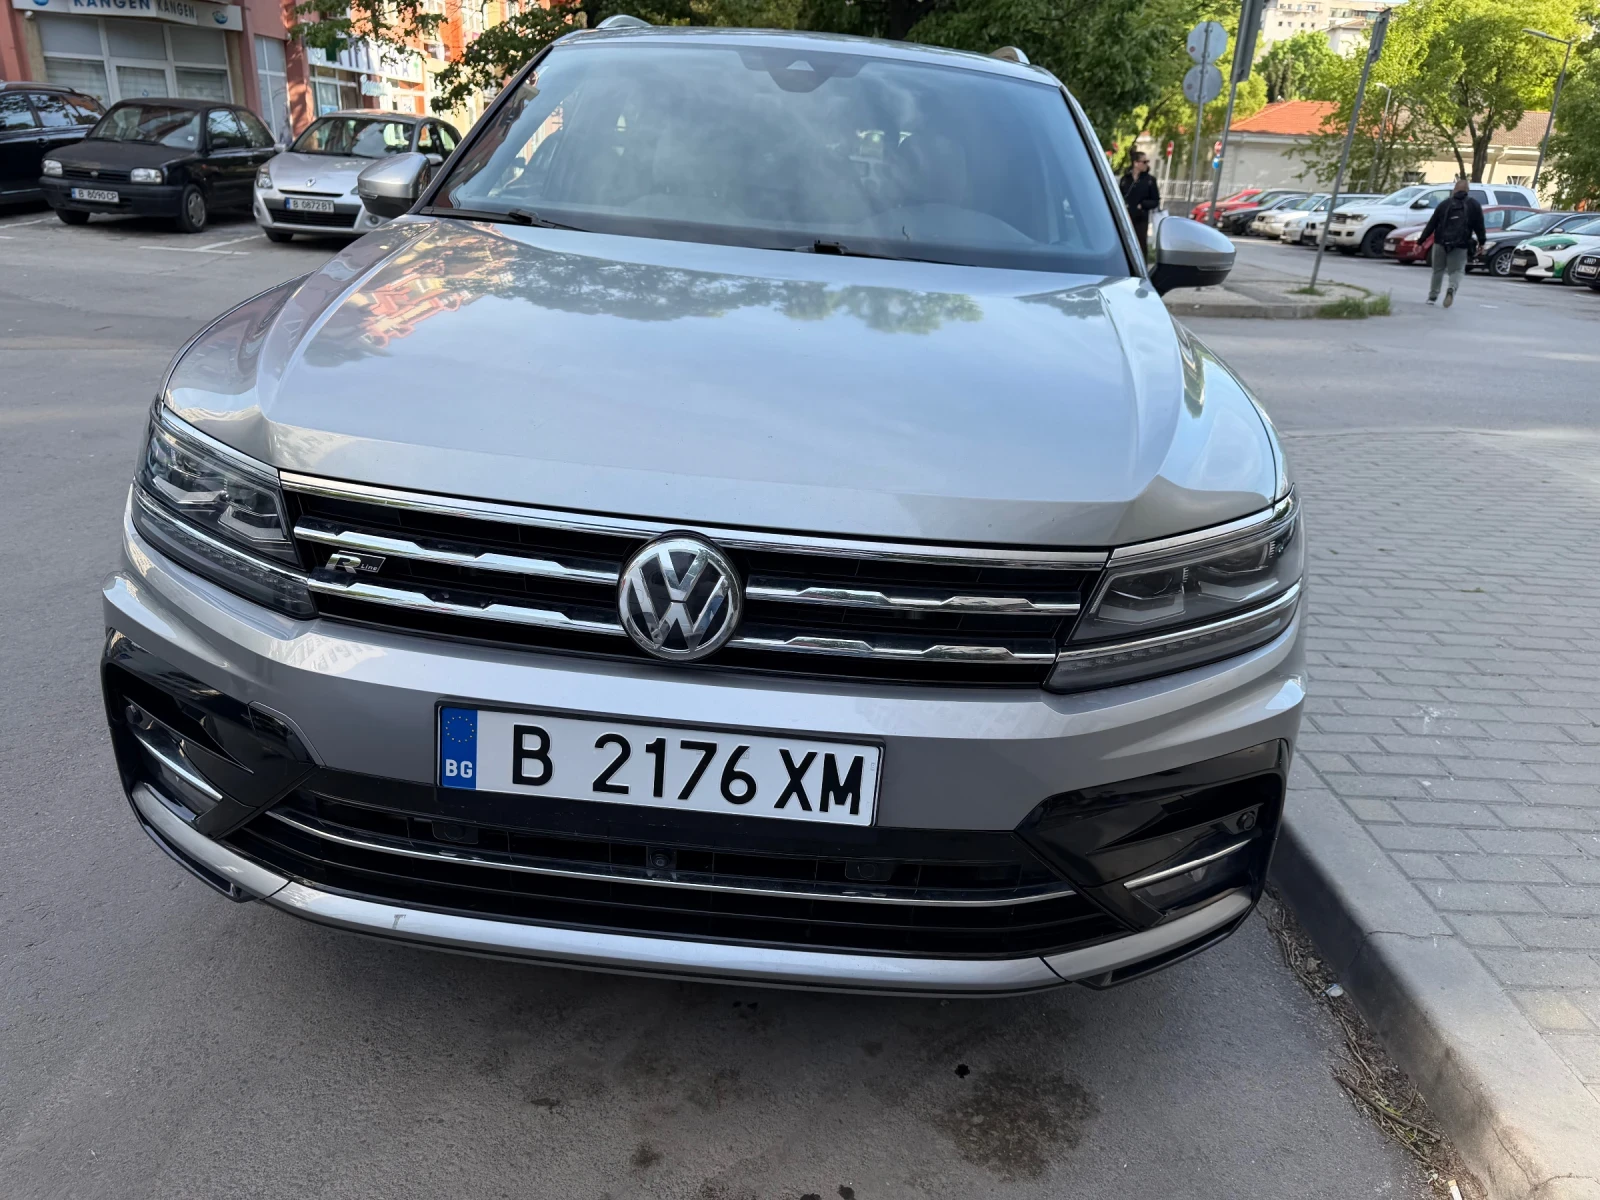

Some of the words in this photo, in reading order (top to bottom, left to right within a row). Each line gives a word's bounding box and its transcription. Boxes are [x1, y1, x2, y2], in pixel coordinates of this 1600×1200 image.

[325, 553, 361, 574] R
[445, 759, 473, 778] BG
[512, 724, 553, 786] B
[592, 733, 757, 804] 2176
[773, 748, 864, 815] XM
